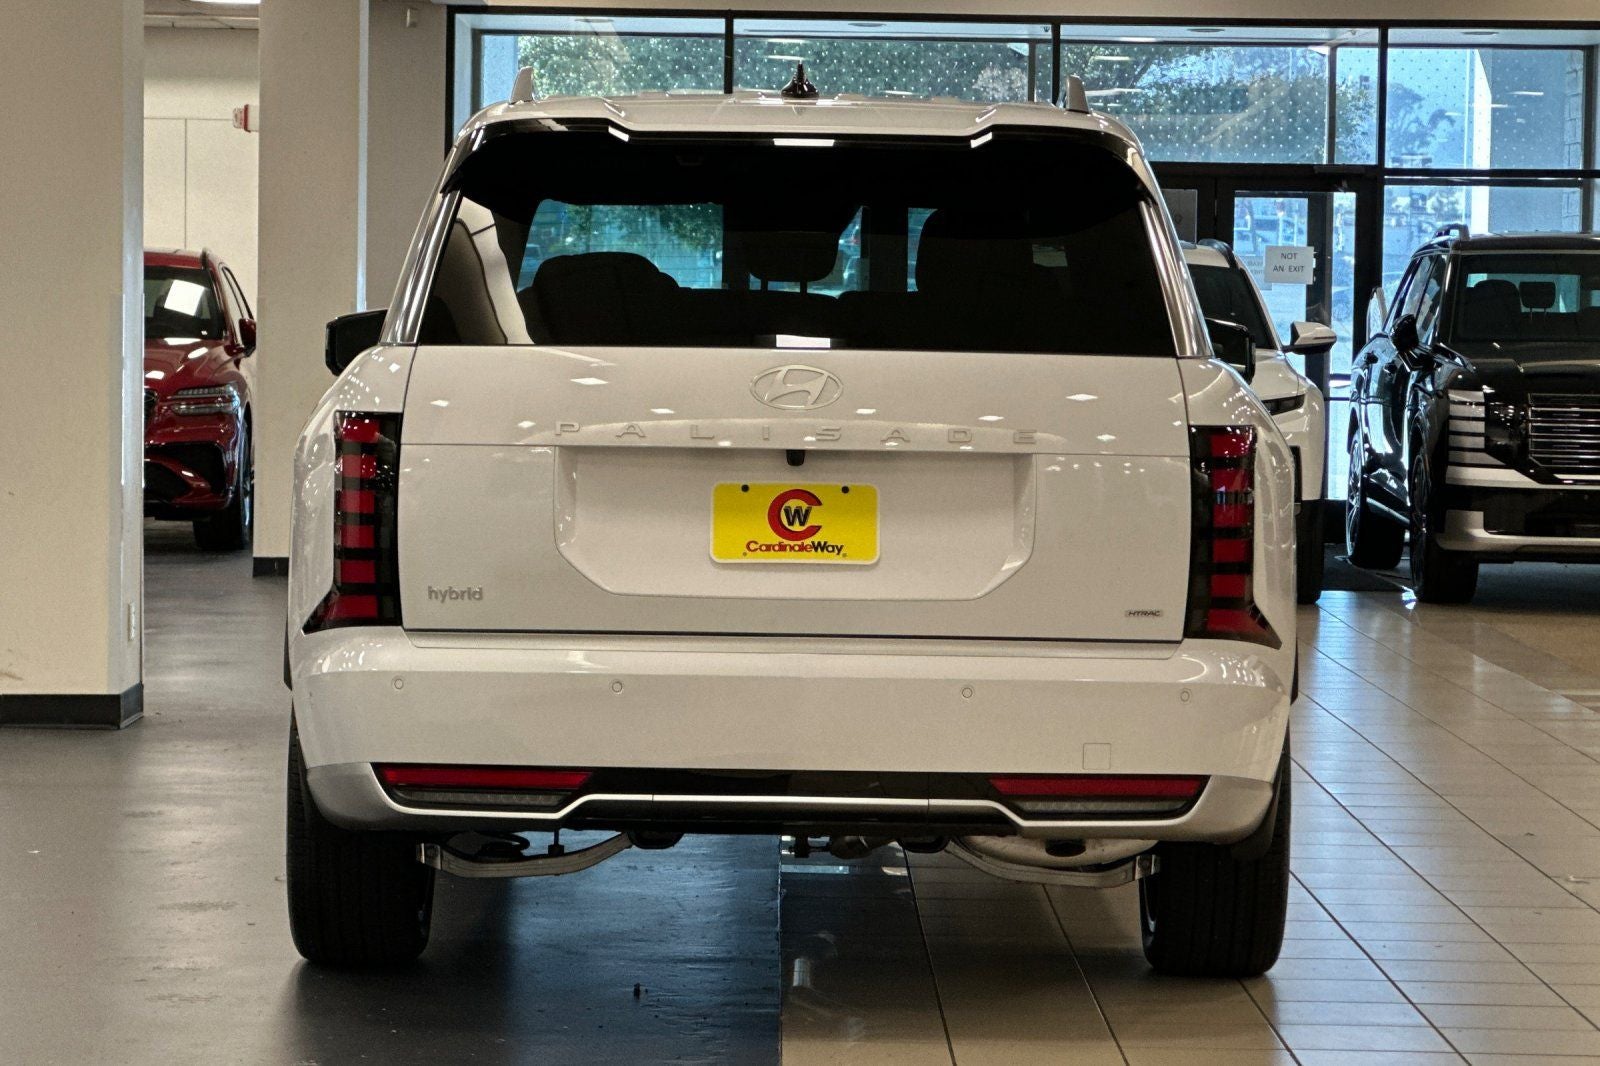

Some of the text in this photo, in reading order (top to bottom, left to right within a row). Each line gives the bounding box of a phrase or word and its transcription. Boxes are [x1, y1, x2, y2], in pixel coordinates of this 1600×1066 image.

[1280, 252, 1298, 260] NOT
[1272, 265, 1284, 273] AN
[1288, 265, 1305, 273] EXIT
[554, 420, 1038, 445] PALISADE
[745, 540, 844, 555] CardinaleWay
[427, 585, 483, 604] hybrid
